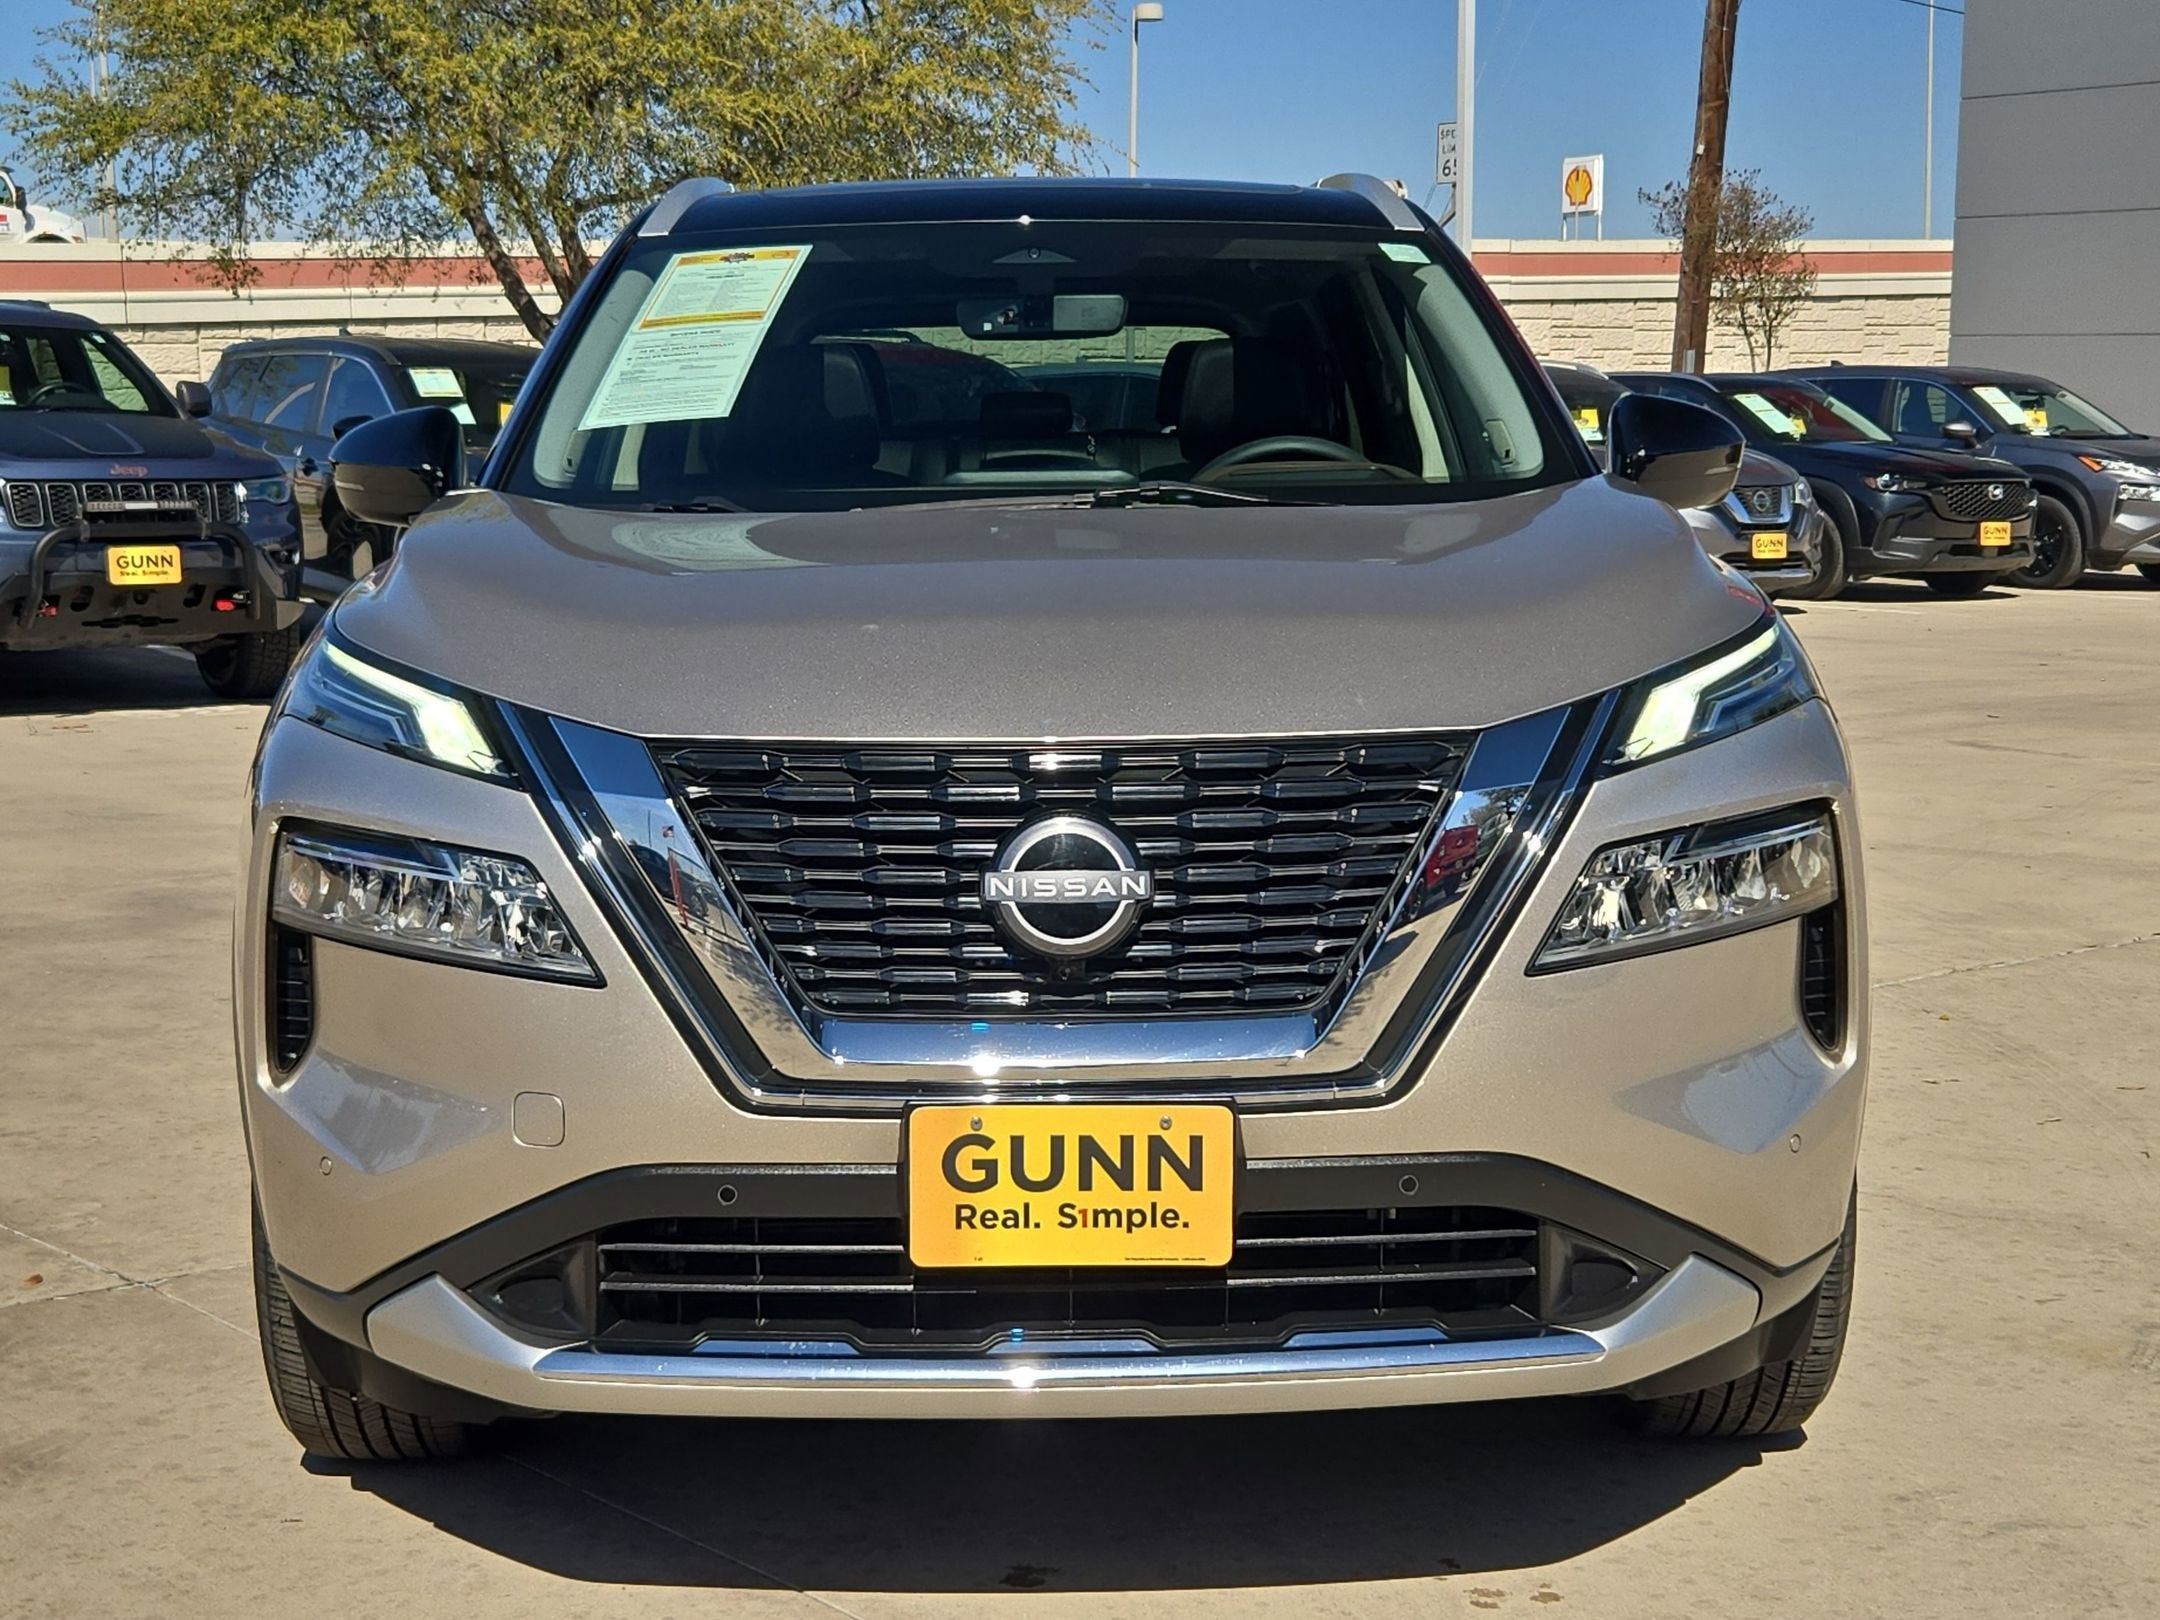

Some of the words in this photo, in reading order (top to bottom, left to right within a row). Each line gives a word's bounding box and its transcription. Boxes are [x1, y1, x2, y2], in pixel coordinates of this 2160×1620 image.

[1440, 129, 1456, 140] SPE
[110, 462, 149, 478] Jeep
[1756, 538, 1784, 548] GUNN
[116, 554, 174, 569] GUNN
[989, 875, 1146, 898] NISSAN
[941, 1132, 1204, 1193] GUNN
[955, 1201, 1041, 1230] Real.
